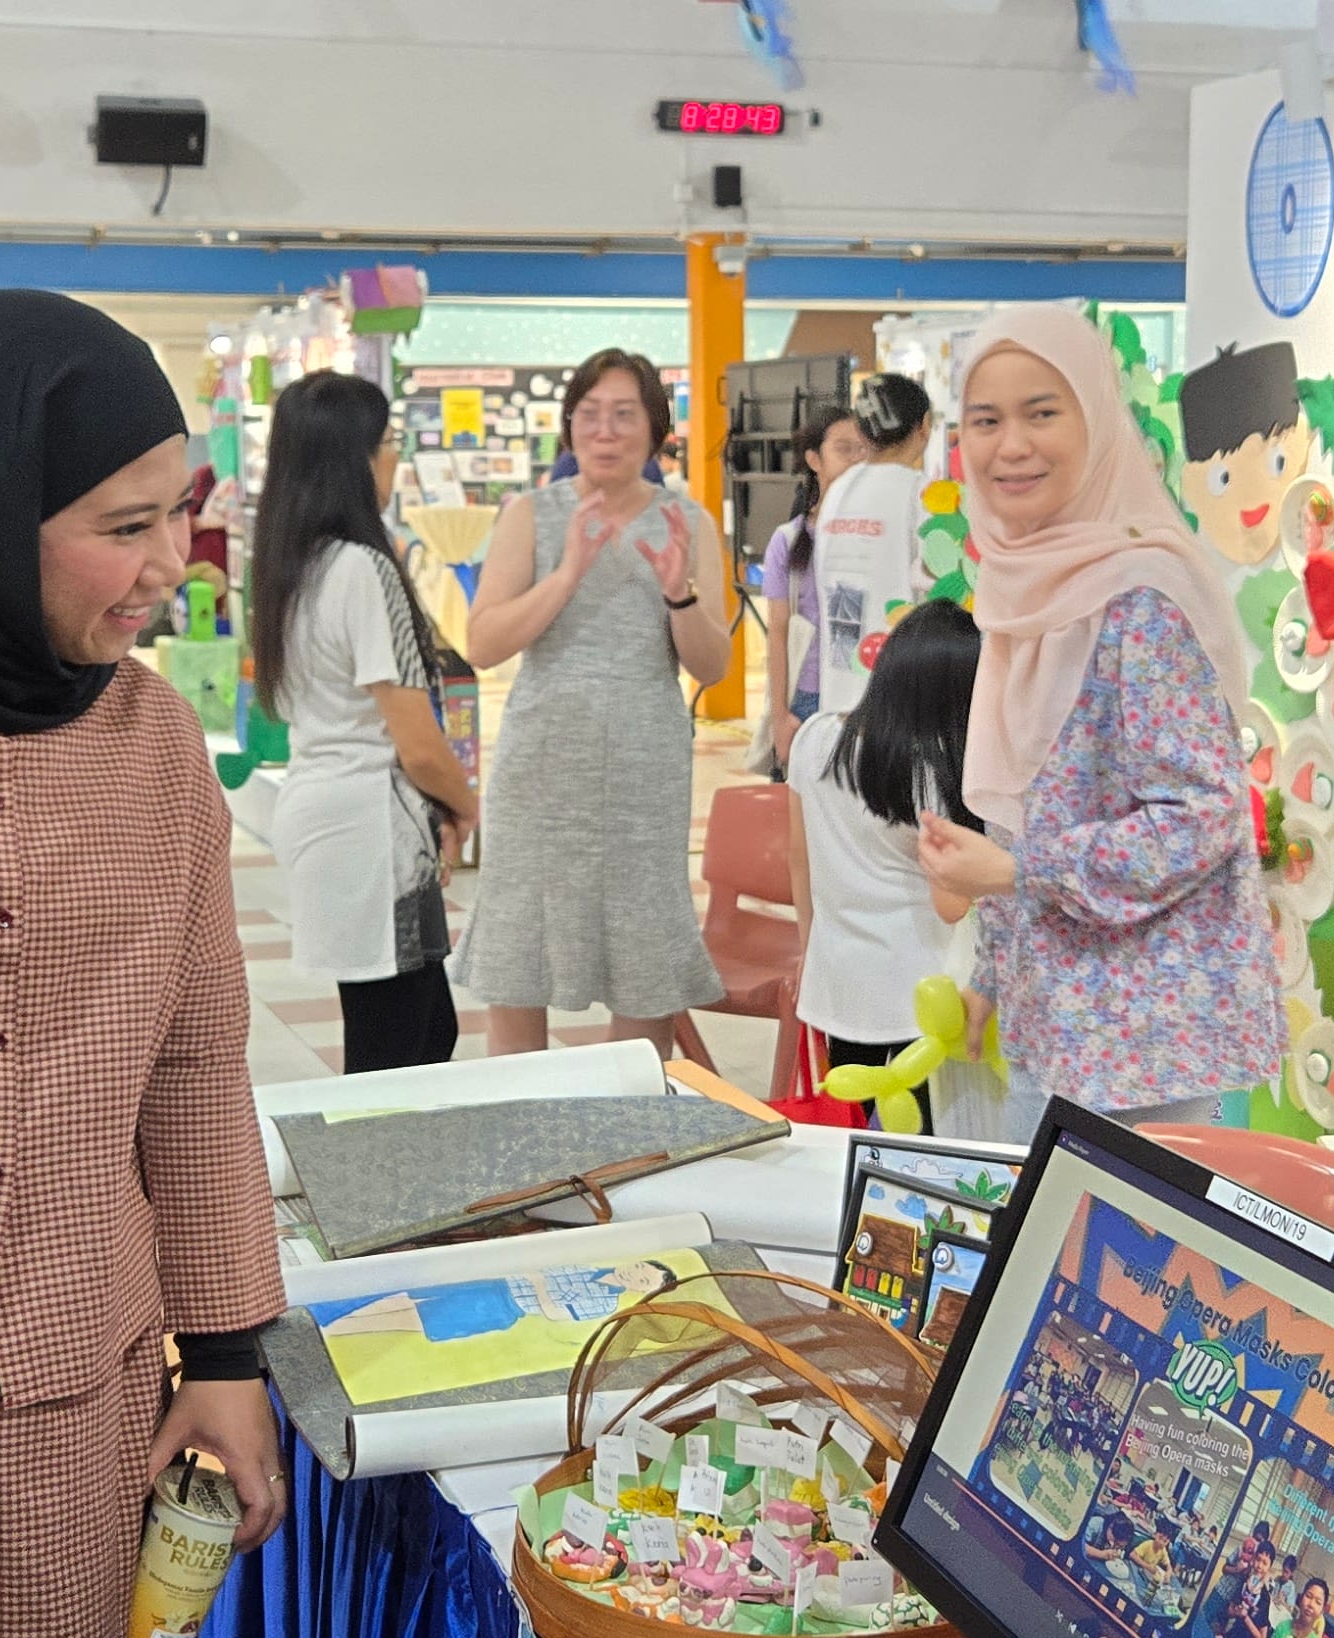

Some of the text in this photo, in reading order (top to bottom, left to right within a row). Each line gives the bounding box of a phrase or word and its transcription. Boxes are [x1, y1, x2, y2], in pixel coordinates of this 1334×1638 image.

[681, 103, 781, 133] 8:28:43
[1233, 1191, 1307, 1241] ICT/LMON/19
[1122, 1257, 1178, 1310] Beijing
[1179, 1289, 1231, 1335] Opera
[1231, 1322, 1292, 1373] Masks
[1171, 1343, 1236, 1407] YUP!
[1125, 1435, 1229, 1477] Beijing Opera masks
[1129, 1414, 1249, 1461] Having fun coloring the
[1283, 1483, 1328, 1523] Different
[169, 1549, 231, 1571] RULES
